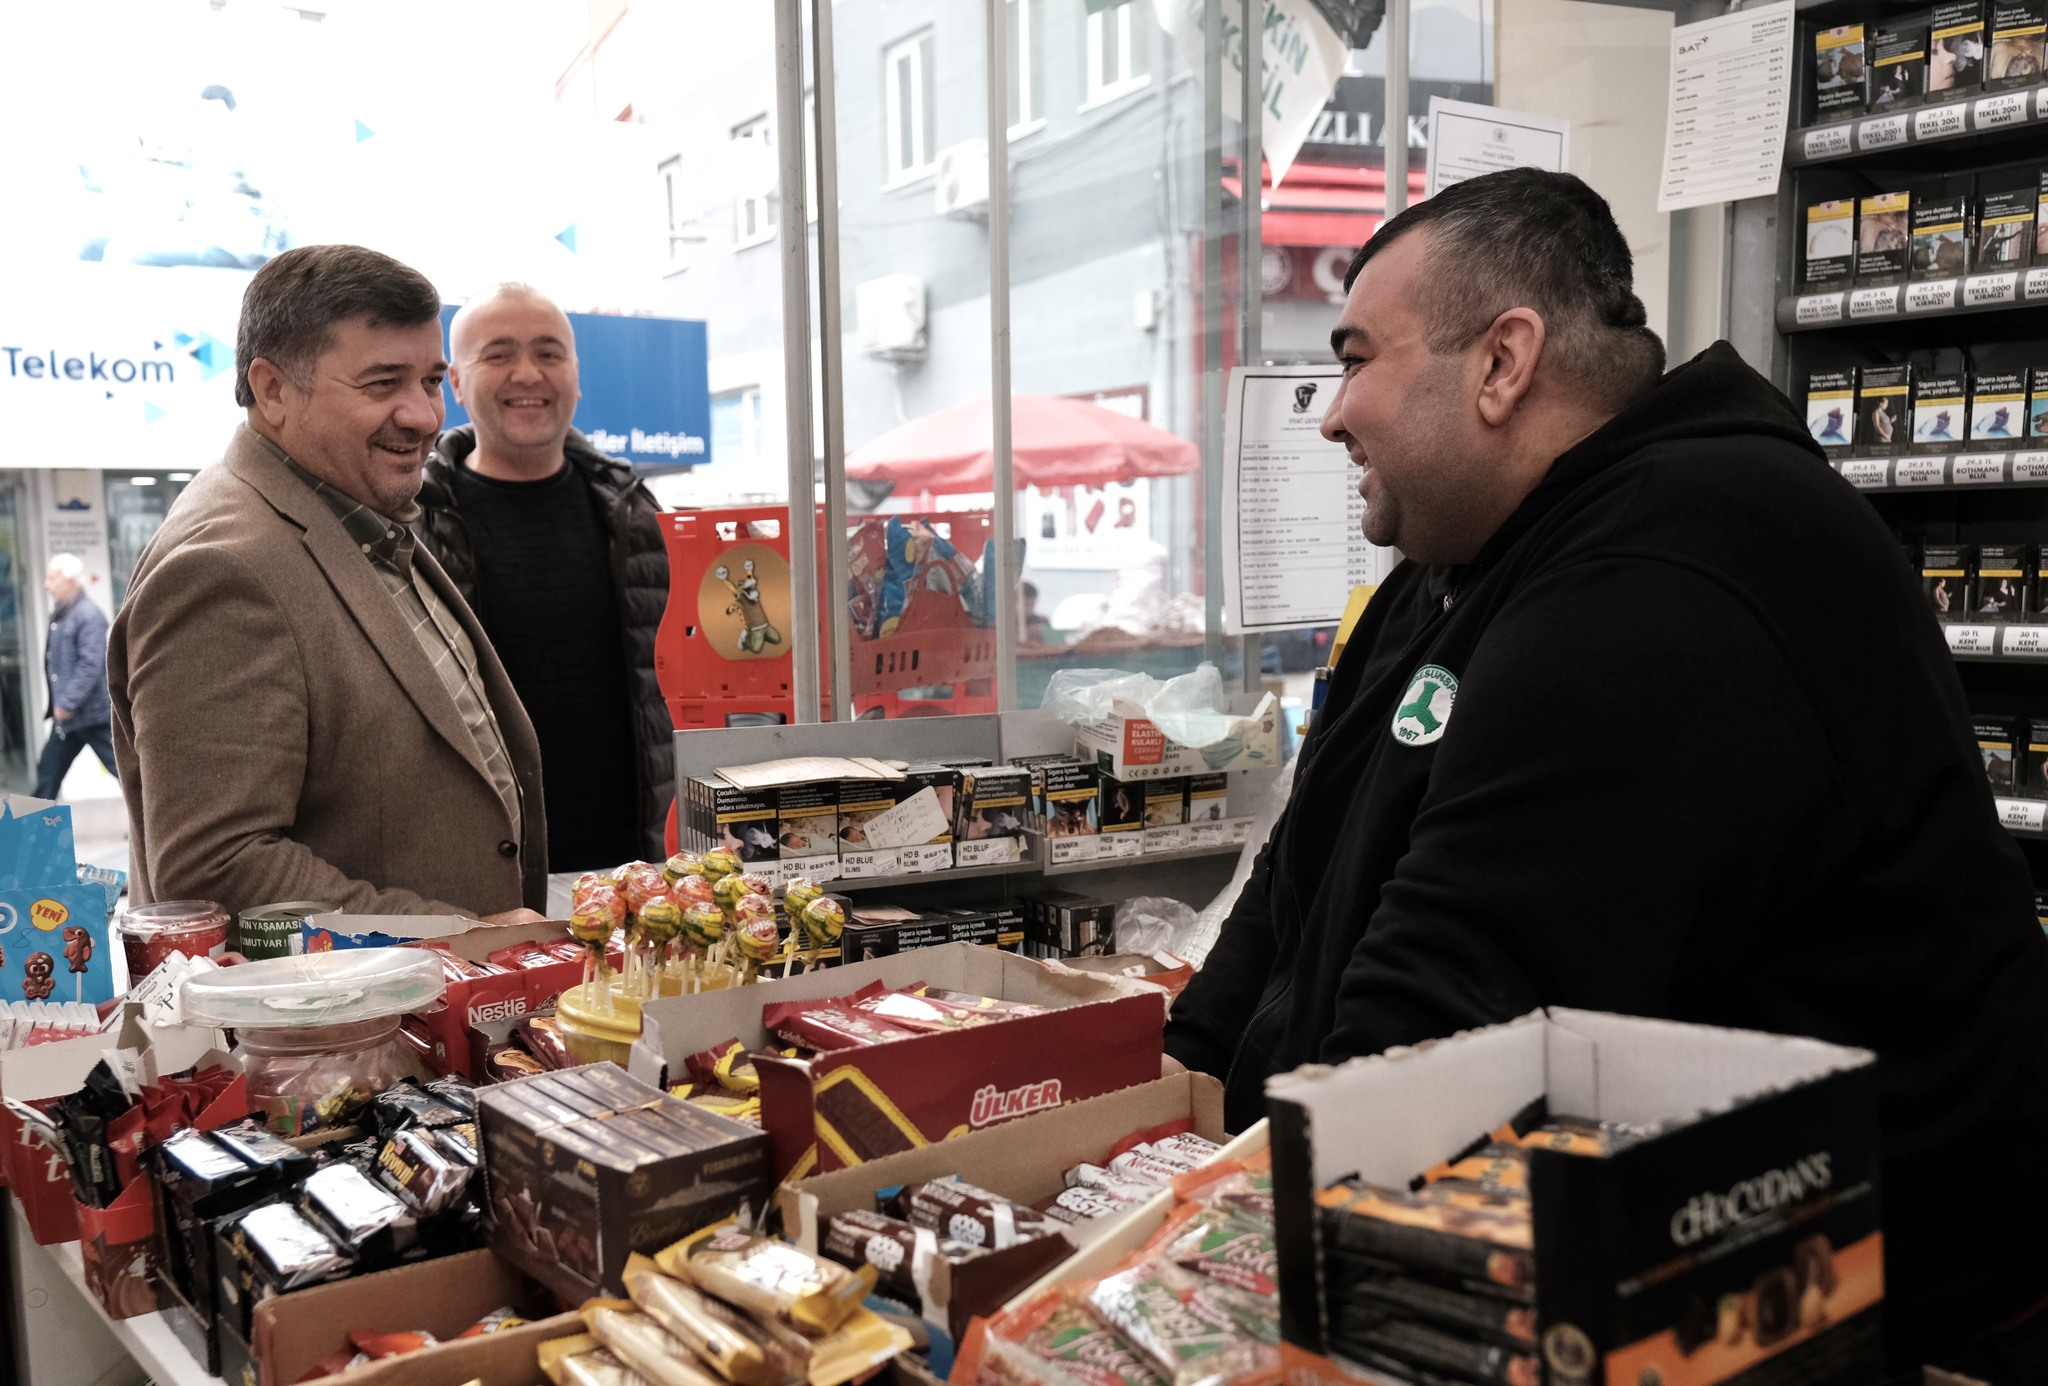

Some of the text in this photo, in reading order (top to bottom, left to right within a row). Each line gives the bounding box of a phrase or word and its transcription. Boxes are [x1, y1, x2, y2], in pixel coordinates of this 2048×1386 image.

[1977, 105, 2021, 118] TEKEL 2001
[1919, 116, 1960, 129] TEKEL 2001
[1990, 116, 2011, 124] MAVİ
[1862, 128, 1902, 140] TEKEL 2001
[1968, 284, 2011, 295] TEKEL 2000
[1909, 291, 1951, 302] TEKEL 2000
[2, 347, 174, 382] Telekom
[1977, 376, 1996, 384] Sigara
[1899, 469, 1940, 477] ROTHMANS
[1956, 466, 2000, 474] ROTHMANS
[1399, 726, 1420, 742] 1967
[1131, 738, 1162, 746] KULAKLI
[1047, 768, 1064, 776] Sigara
[716, 804, 735, 812] onlara
[2007, 813, 2028, 821] KENT
[962, 845, 972, 853] HD
[903, 851, 914, 859] HD
[962, 854, 978, 862] SLIMS
[845, 856, 874, 865] HD BLUE
[903, 860, 919, 868] SLIMS
[783, 862, 794, 871] HD
[35, 904, 64, 923] YENİ
[998, 917, 1023, 925] kanserine
[952, 920, 986, 932] Sigara içmek
[898, 928, 932, 939] Sigara içmek
[952, 928, 997, 939] gırtlak kanserine
[262, 939, 283, 948] VAR
[898, 934, 946, 945] ölümcül amfizeme
[467, 997, 527, 1026] Nestlé
[971, 1079, 1061, 1126] ÜLKER
